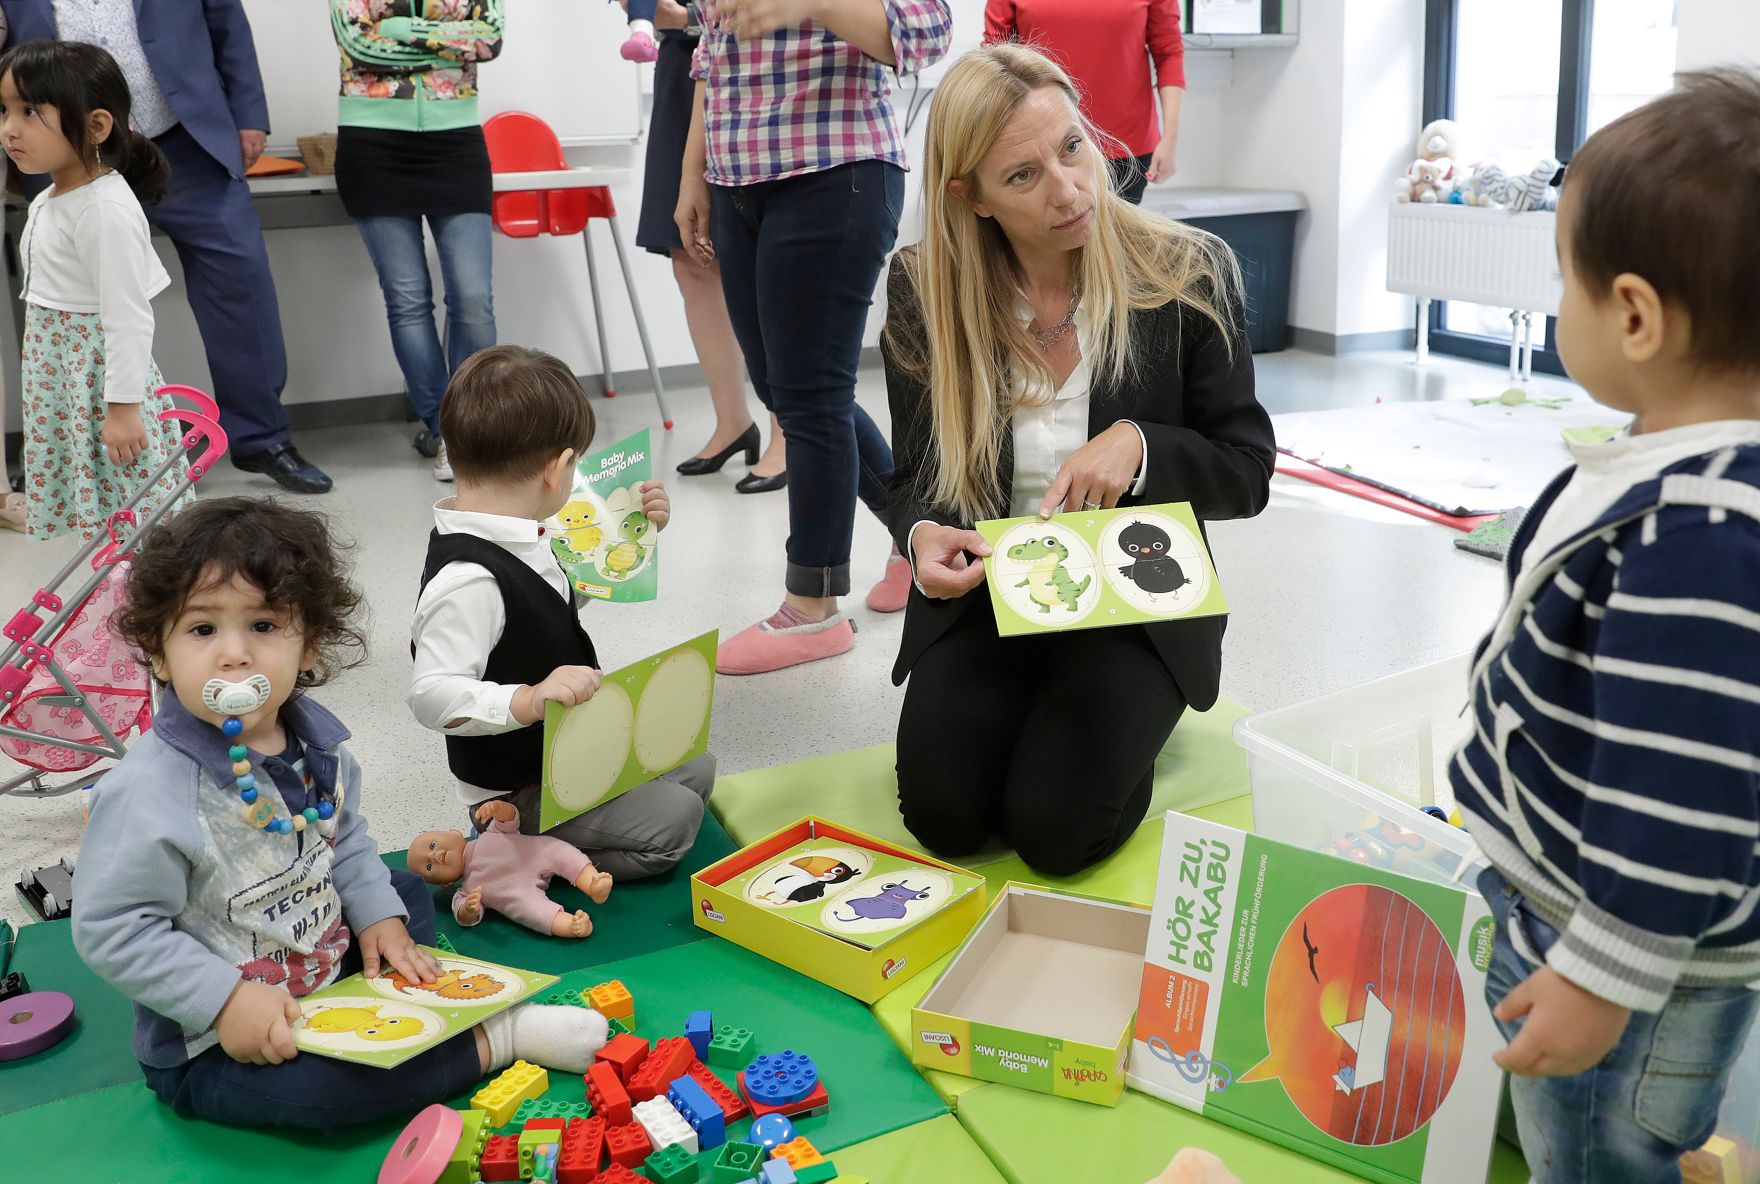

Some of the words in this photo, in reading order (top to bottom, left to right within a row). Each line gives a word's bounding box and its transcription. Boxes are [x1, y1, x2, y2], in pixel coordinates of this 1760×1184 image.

[584, 460, 627, 485] Memoria
[627, 451, 645, 467] Mix
[600, 450, 625, 469] Baby
[1179, 838, 1207, 888] ZU,
[1193, 840, 1230, 973] BAKABU
[1241, 925, 1257, 987] SPRACHLICHEN
[1252, 854, 1268, 925] FRÜHFÖRDERUNG
[1166, 896, 1195, 965] HÖR
[1232, 926, 1247, 984] KINDERLIEDER
[1241, 909, 1250, 926] ZUR
[1475, 926, 1489, 966] musik
[1165, 982, 1175, 1008] ALBUM
[975, 1044, 995, 1057] Mix
[998, 1049, 1049, 1068] Memoria
[999, 1057, 1028, 1073] Baby
[1075, 1057, 1096, 1068] baby
